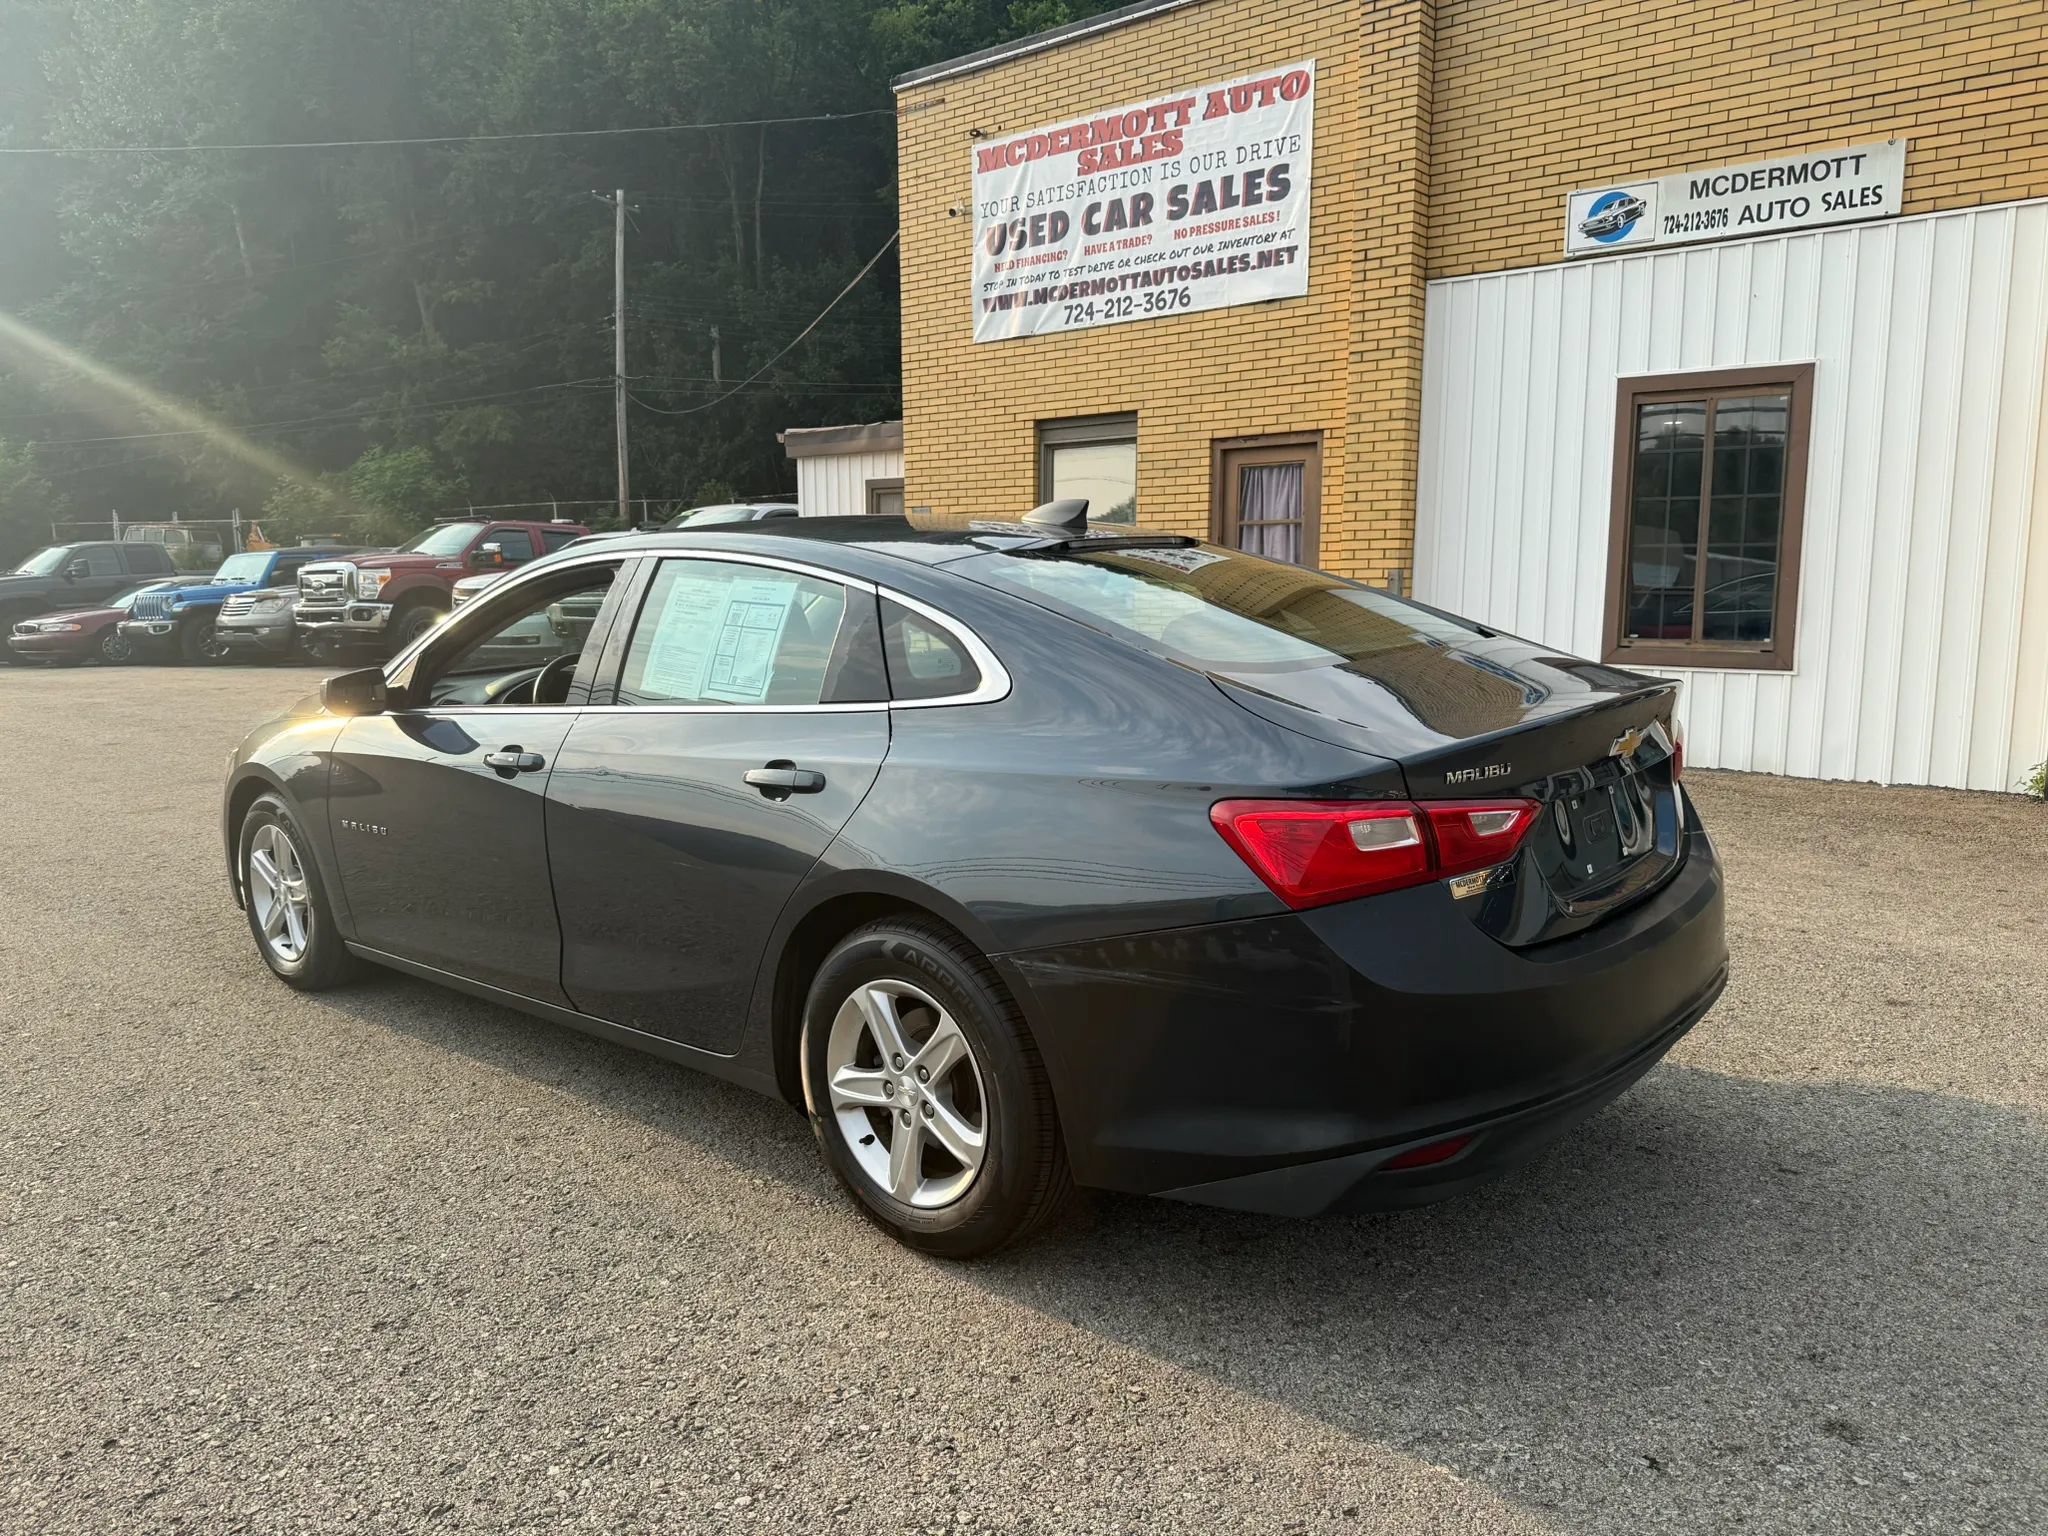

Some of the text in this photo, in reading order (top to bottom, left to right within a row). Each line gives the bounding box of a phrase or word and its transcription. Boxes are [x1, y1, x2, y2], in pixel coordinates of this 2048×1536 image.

[977, 69, 1311, 174] MCDERMOTT AUTO
[1077, 129, 1185, 176] SALES
[981, 134, 1302, 218] YOUR SATISFACTION IS OUR DRIVE
[1689, 153, 1868, 200] MCDERMOTT
[985, 163, 1291, 256] USED CAR SALES
[1664, 208, 1729, 236] 724-212-3676
[1737, 184, 1883, 226] AUTO SALES
[1084, 234, 1153, 256] HAVE A TRADE?
[1173, 228, 1188, 240] NO
[1189, 219, 1242, 238] PRESSURE
[994, 249, 1068, 273] NED FINANCING?
[1006, 277, 1018, 288] IN
[1020, 271, 1047, 285] TODAY
[1048, 269, 1061, 280] TO
[1063, 265, 1086, 277] TEST
[1087, 260, 1115, 273] DRIVE
[1117, 257, 1132, 269] OR
[1134, 251, 1166, 267] CHECK
[1168, 247, 1192, 261] OUT
[1193, 243, 1215, 257] OUR
[1217, 231, 1278, 253] INVENTORY
[1279, 228, 1297, 241] AT
[982, 245, 1299, 314] WWW.MCDERMOTTAUTOSALES.NET
[1064, 286, 1192, 325] 724-212-3676
[1446, 762, 1511, 784] MALIBU
[342, 819, 388, 836] MALIBU
